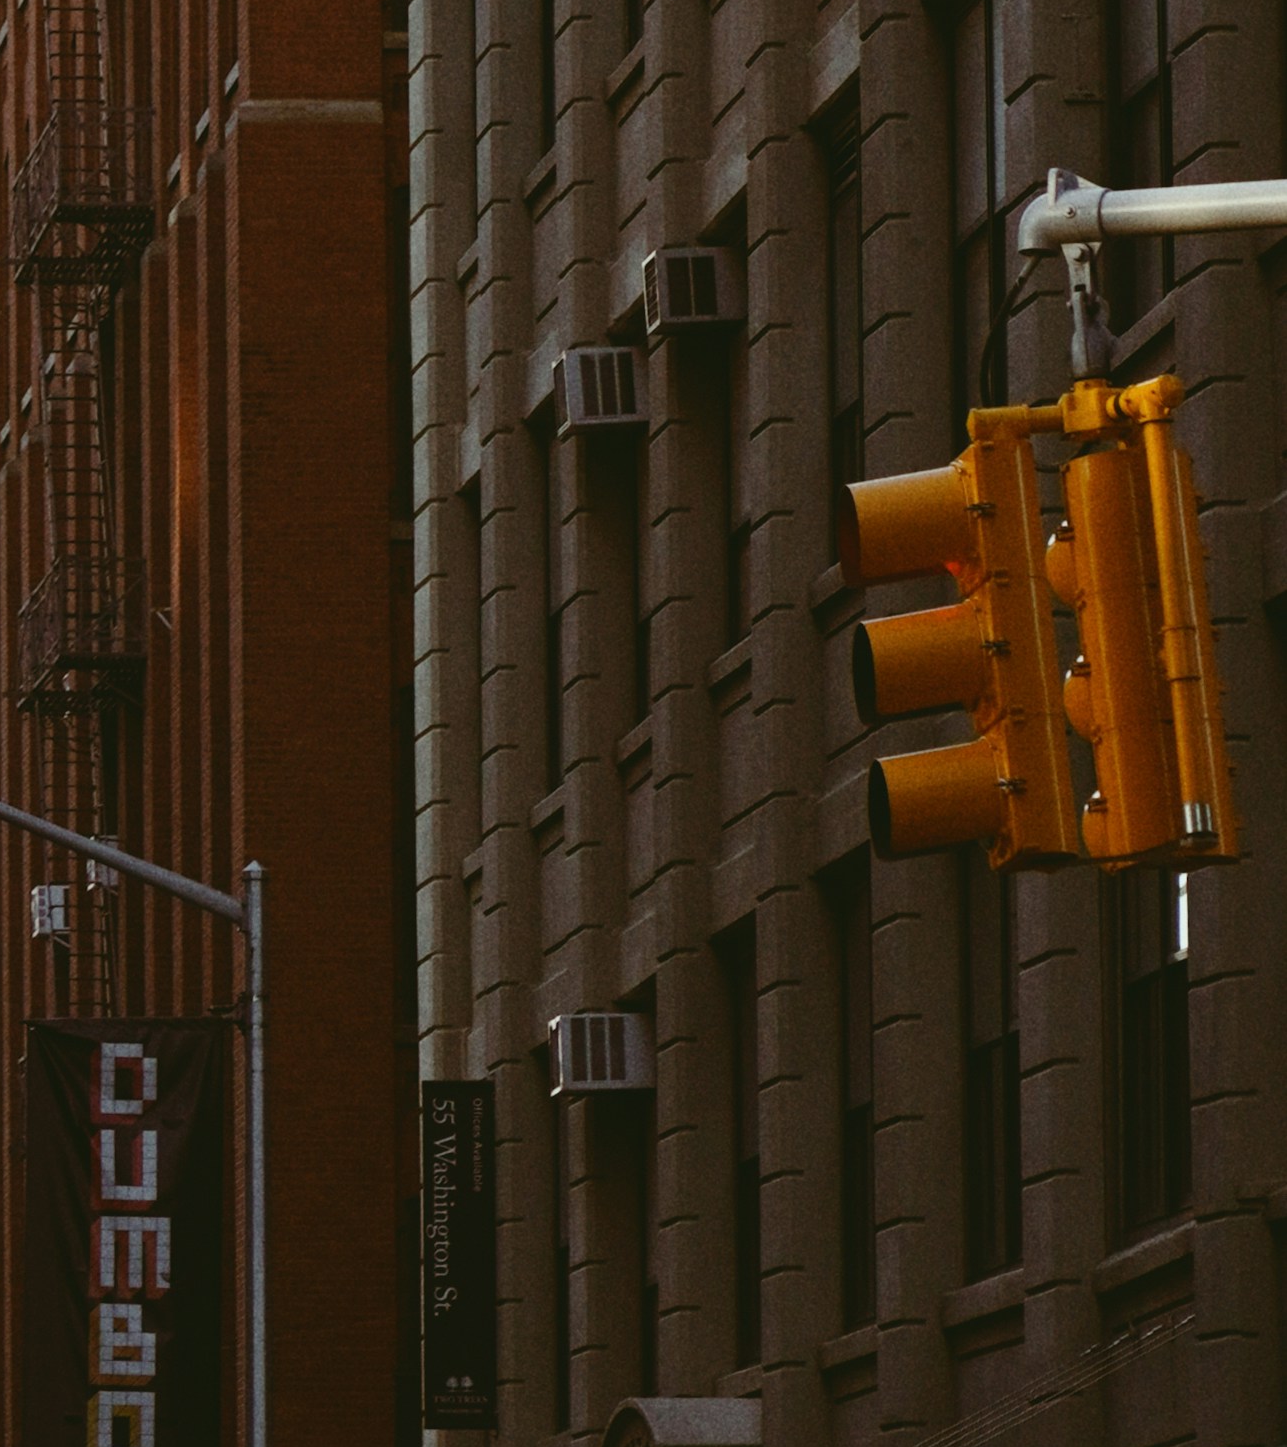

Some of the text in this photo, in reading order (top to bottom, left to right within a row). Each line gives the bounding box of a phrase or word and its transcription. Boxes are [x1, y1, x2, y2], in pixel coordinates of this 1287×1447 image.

[426, 1097, 458, 1318] 55 Washington St.
[473, 1097, 483, 1193] Offices Available
